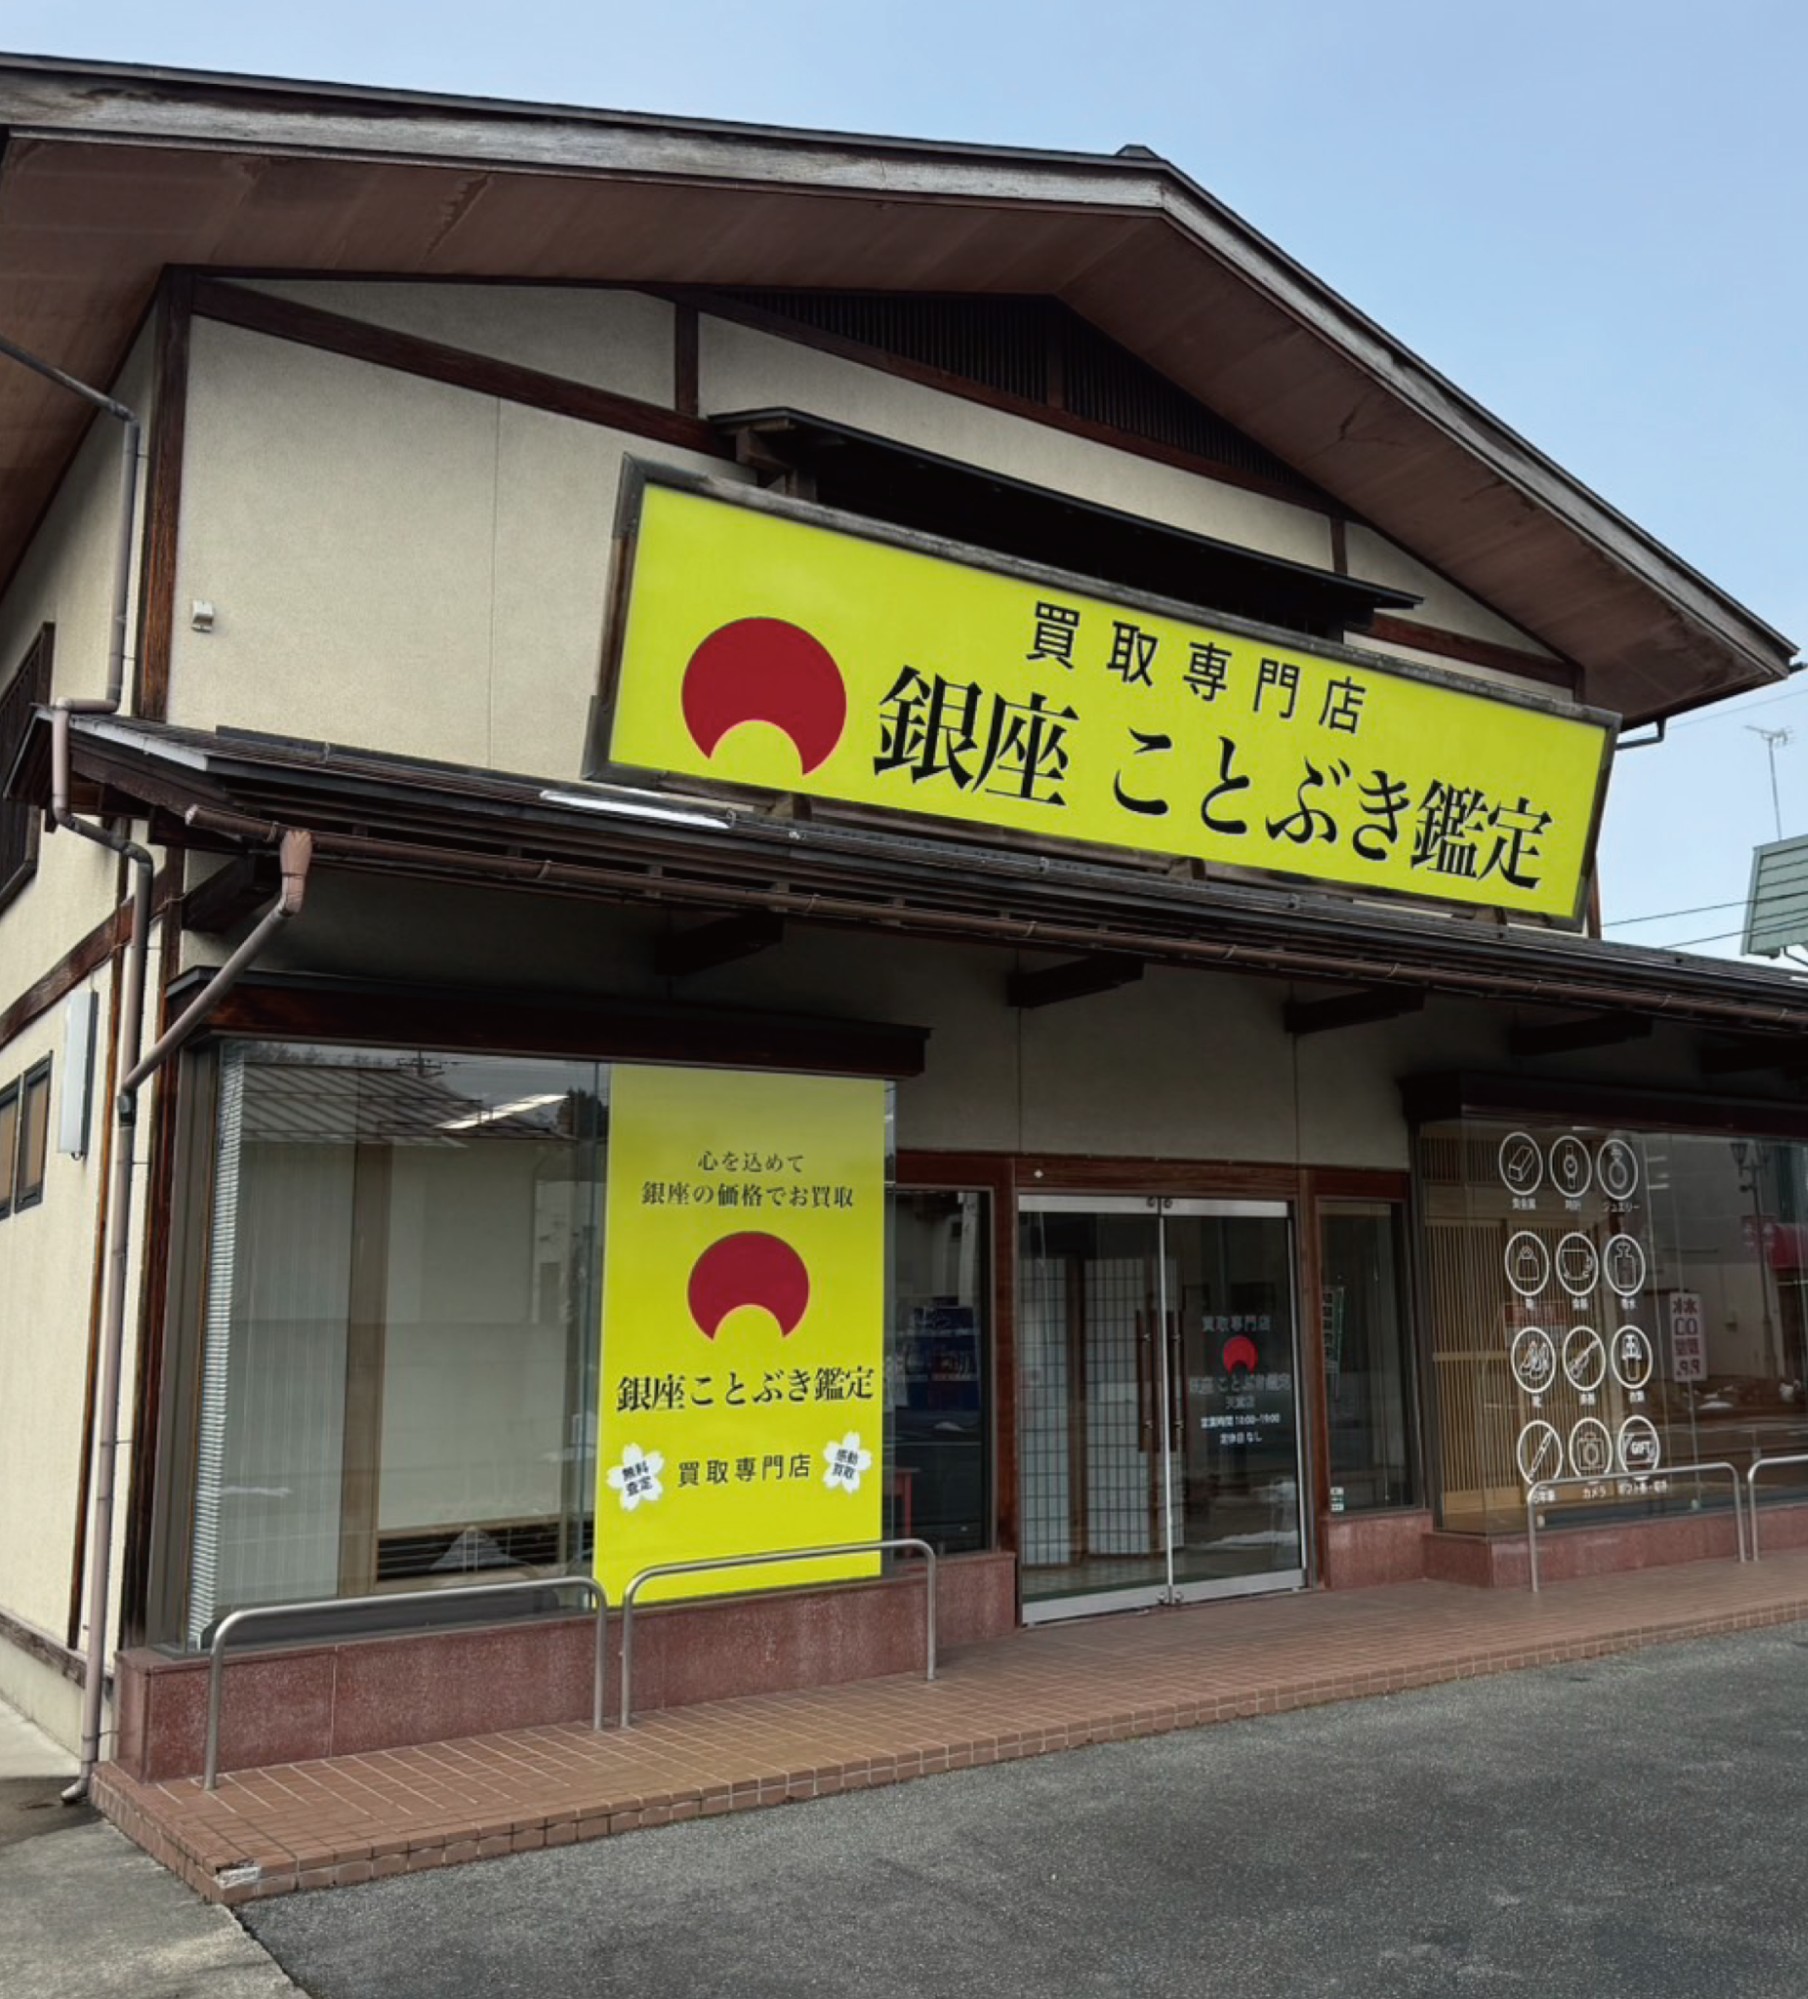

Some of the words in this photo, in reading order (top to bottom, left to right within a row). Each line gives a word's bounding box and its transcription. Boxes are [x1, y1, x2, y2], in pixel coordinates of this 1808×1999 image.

[1025, 601, 1367, 734] 買取専門店
[874, 666, 1078, 806] 銀座
[1112, 725, 1553, 890] ことぶき鑑定
[698, 1150, 804, 1173] 心を込めて
[641, 1180, 854, 1209] 銀座の価格でお買取
[616, 1365, 874, 1412] 銀座ことぶき鑑定
[622, 1460, 649, 1481] 無料
[678, 1452, 811, 1488] 買取専門店
[832, 1463, 856, 1480] 買取
[625, 1476, 653, 1497] 査定
